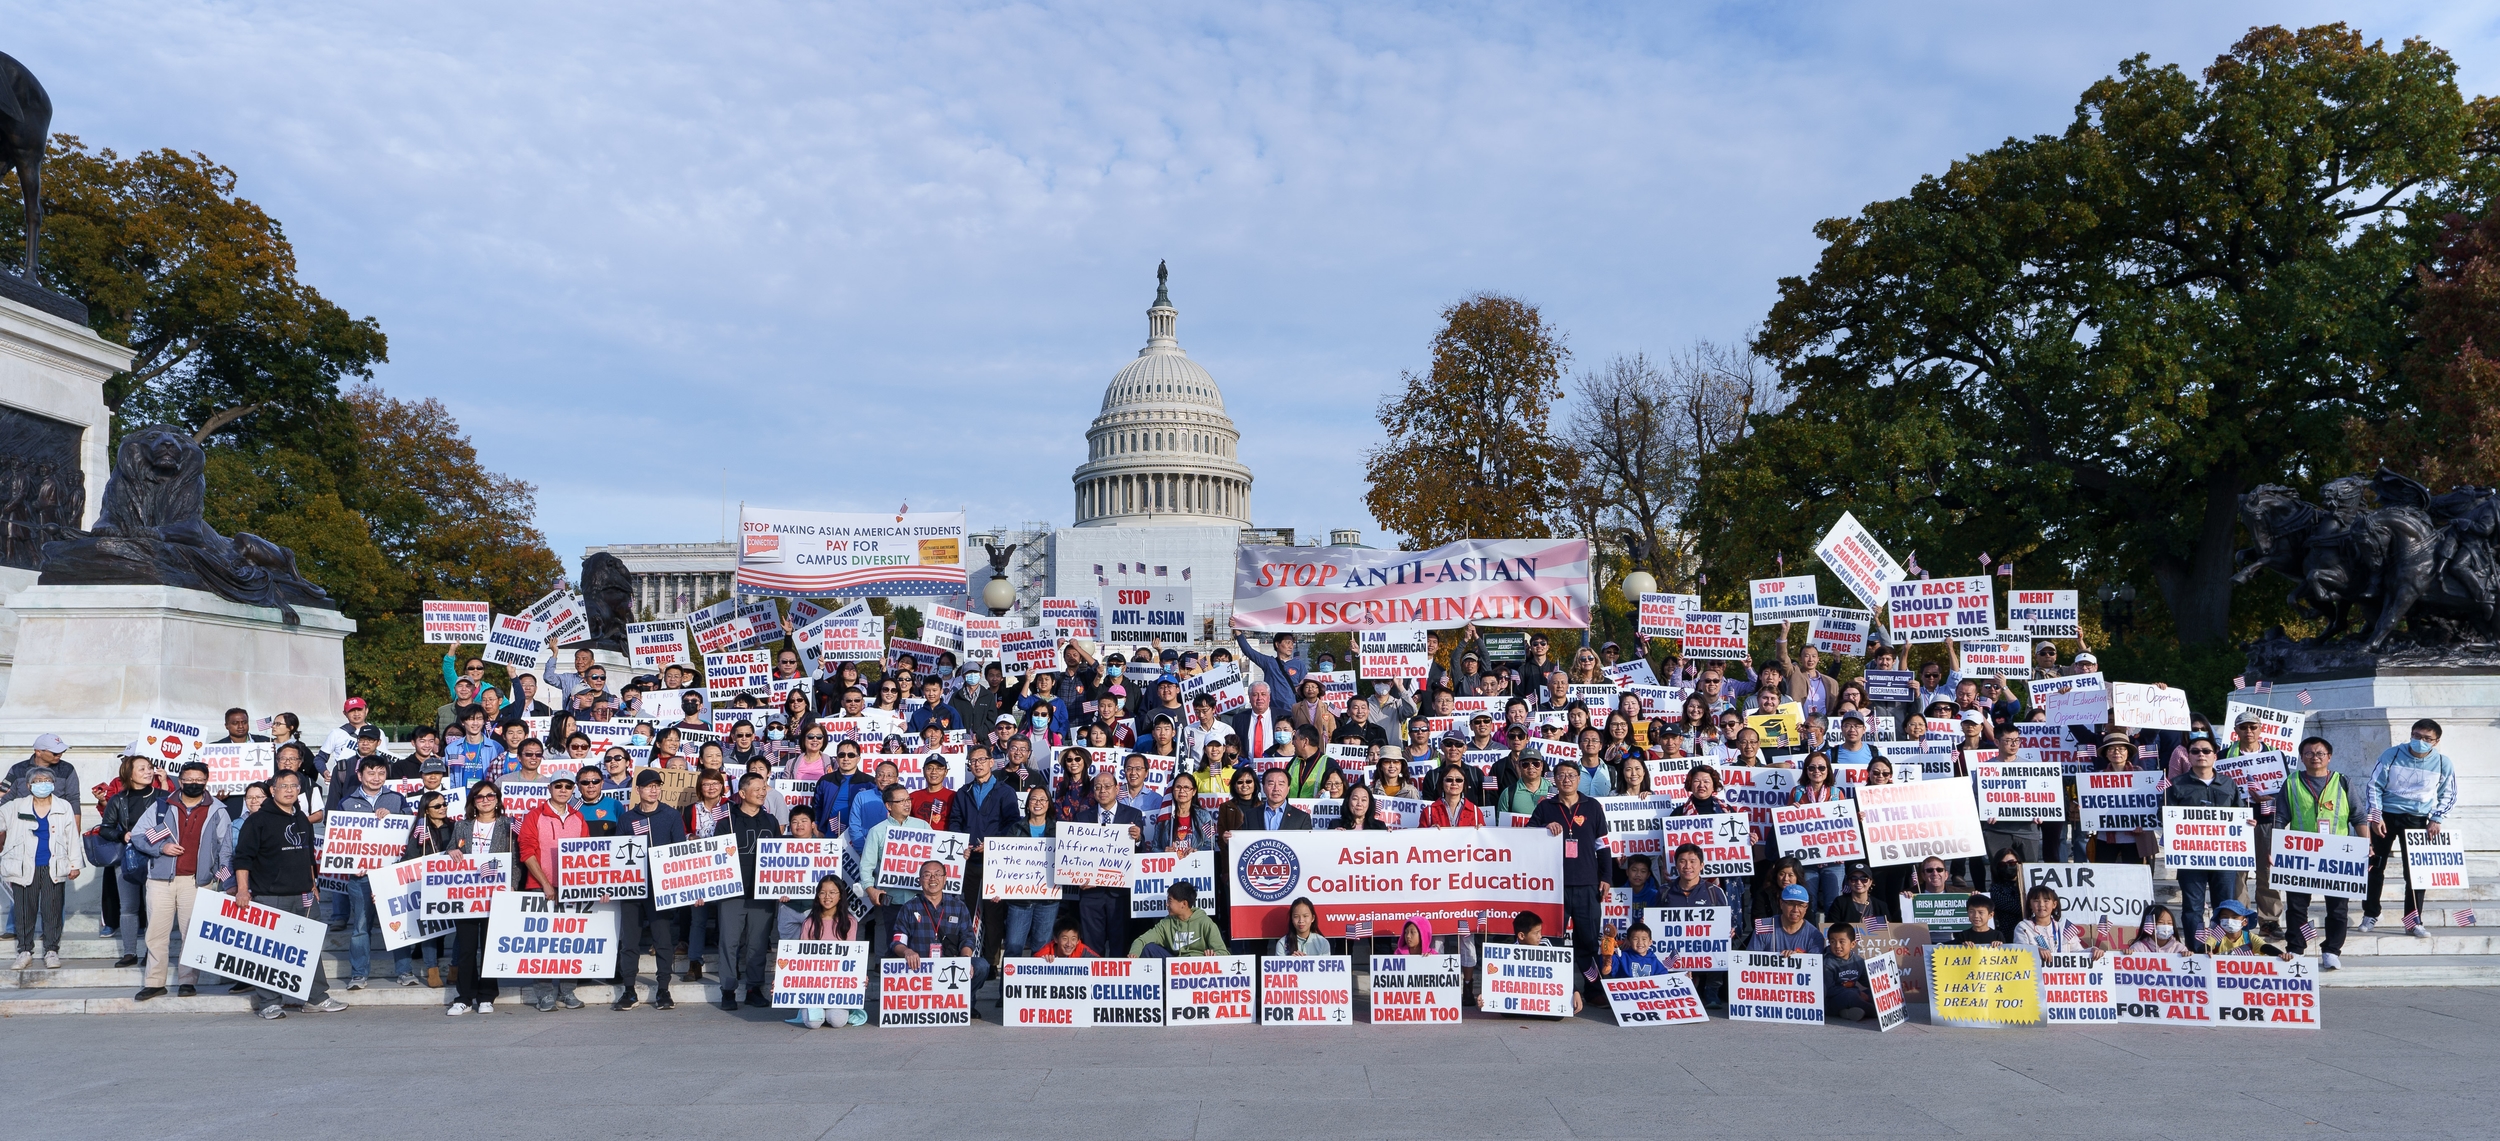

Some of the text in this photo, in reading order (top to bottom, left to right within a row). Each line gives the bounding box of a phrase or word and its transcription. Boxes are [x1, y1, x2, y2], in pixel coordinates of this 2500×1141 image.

[743, 521, 961, 537] STOP MAKING ASIAN AMERICAN STUDENTS
[747, 538, 779, 547] CONNECTICUT
[826, 540, 878, 552] PAY FOR
[796, 553, 910, 566] CAMPUS DIVERSITY
[1256, 557, 1539, 588] STOP ANTI-ASIAN
[1890, 581, 1966, 598] MY RACE
[1118, 589, 1150, 605] STOP
[1891, 594, 1989, 613] SHOULD NOT
[424, 602, 488, 613] DISCRIMINATION
[1284, 595, 1572, 626] DISCRIMINATION
[425, 613, 488, 623] IN THE NAME OF
[1147, 610, 1186, 628] ASIAN
[1685, 613, 1723, 623] SUPPORT
[1893, 610, 1987, 629] HURT ME
[425, 623, 477, 633] DIVERSITY
[627, 621, 686, 634] HELP STUDENTS
[1685, 624, 1721, 635] RACE
[1893, 626, 1990, 642] IN ADMISSIONS
[431, 632, 484, 641] IS WRONG
[641, 634, 674, 643] IN NEEDS
[1110, 630, 1188, 643] DISCRIMINATION
[1685, 638, 1746, 649] NEUTRAL
[635, 643, 683, 656] REGARDLESS
[1684, 649, 1747, 659] ADMISSIONS
[645, 654, 676, 665] OF RACE
[2049, 690, 2107, 710] Equal Education
[2053, 710, 2102, 726] Opportunity!
[150, 718, 201, 737] HARVARD
[162, 742, 183, 755] STOP
[1978, 766, 2060, 779] 73% AMERICANS
[1981, 779, 2027, 792] SUPPORT
[1986, 792, 2056, 804] COLOR-BLIND
[1998, 807, 2063, 820] ADMISSIONS
[330, 814, 410, 831] SUPPORT SFFA
[328, 828, 363, 842] FAIR
[1067, 825, 1120, 842] ABOLISH
[2407, 832, 2451, 847] FAIRNESS
[988, 840, 1056, 853] Discriminatio
[1057, 840, 1130, 857] Affirmative
[2284, 834, 2324, 853] STOP
[326, 842, 406, 860] ADMISSIONS
[1241, 840, 1297, 863] ASIAN AMERICAN
[1338, 843, 1512, 865] Asian American
[324, 857, 384, 871] FOR ALL
[987, 857, 998, 866] in
[1003, 855, 1022, 866] the
[1025, 859, 1049, 869] name
[1060, 854, 1094, 868] Action
[2318, 856, 2365, 877] ASIAN
[2410, 852, 2464, 867] EXCELLENCE
[995, 869, 1046, 886] Diversity
[1056, 868, 1125, 881] Judge merit
[1251, 865, 1287, 876] AACE
[1306, 873, 1554, 893] Coalition for Education
[2030, 867, 2095, 890] FAIR
[2271, 873, 2367, 896] DISCRIMINATION
[2431, 872, 2461, 887] MERIT
[985, 884, 996, 895] IS
[1915, 900, 1933, 909] IRISH
[2059, 896, 2154, 916] DMISSIO
[220, 899, 282, 932] MERIT
[1661, 908, 1715, 922] FIX K-12
[1934, 909, 1956, 917] AGAINST
[1664, 924, 1712, 938] DO NOT
[199, 920, 310, 969] EXCELLENCE
[797, 943, 850, 957] JUDGE by
[1651, 939, 1730, 954] SCAPEGOAT
[788, 959, 857, 975] CONTENT OF
[1373, 957, 1406, 971] I AM
[1944, 955, 2019, 966] I AM ASIAN
[2113, 956, 2172, 974] EQUAL
[214, 951, 303, 994] FAIRNESS
[1017, 964, 1089, 978] DISCRIMINATING
[1966, 970, 2031, 981] AMERICAN
[782, 976, 858, 991] CHARACTERS
[1373, 974, 1460, 988] ASIAN AMERICAN
[1944, 982, 2003, 993] I HAVE A
[2114, 972, 2206, 989] EDUCATION
[773, 992, 864, 1007] NOT SKIN COLOR
[1005, 985, 1088, 1001] ON THE BASIS
[1373, 991, 1436, 1005] I HAVE A
[2138, 988, 2210, 1005] RIGHTS
[1943, 997, 2024, 1009] DREAM TOO!
[1019, 1008, 1073, 1025] OF RACE
[1373, 1007, 1460, 1022] DREAM TOO
[2116, 1002, 2211, 1021] FOR ALL
